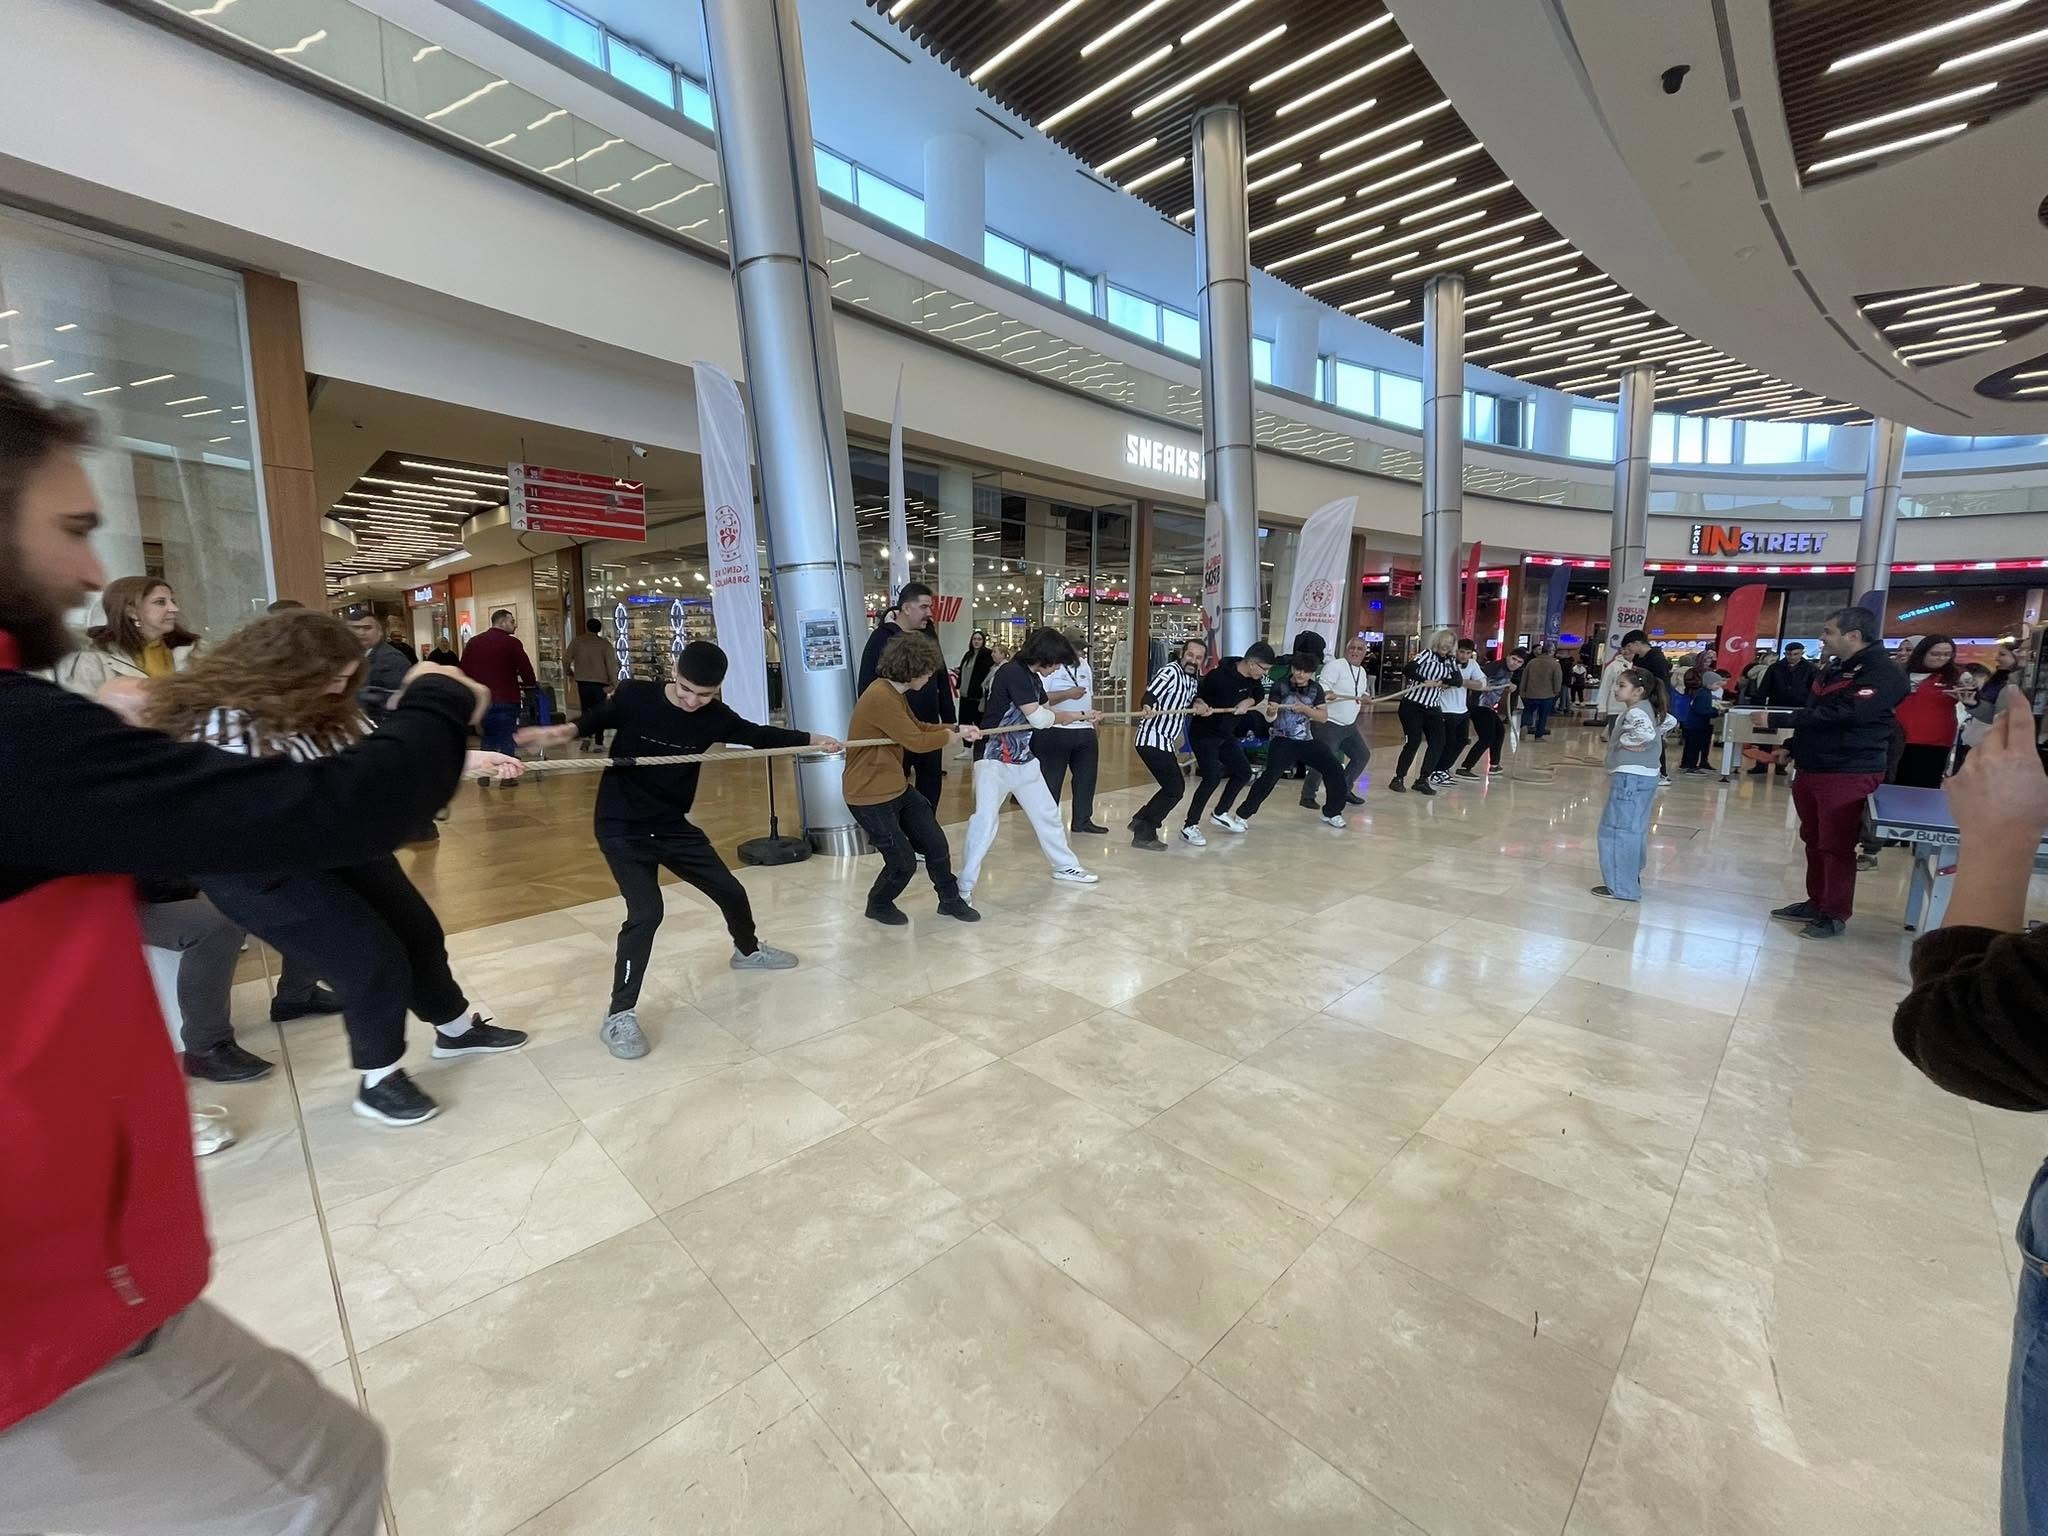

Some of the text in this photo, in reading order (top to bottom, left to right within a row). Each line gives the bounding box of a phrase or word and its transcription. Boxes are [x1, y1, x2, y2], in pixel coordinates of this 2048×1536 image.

[1125, 433, 1200, 480] SNEAKS
[1691, 524, 1701, 555] SPORT
[1617, 612, 1644, 624] SPOR
